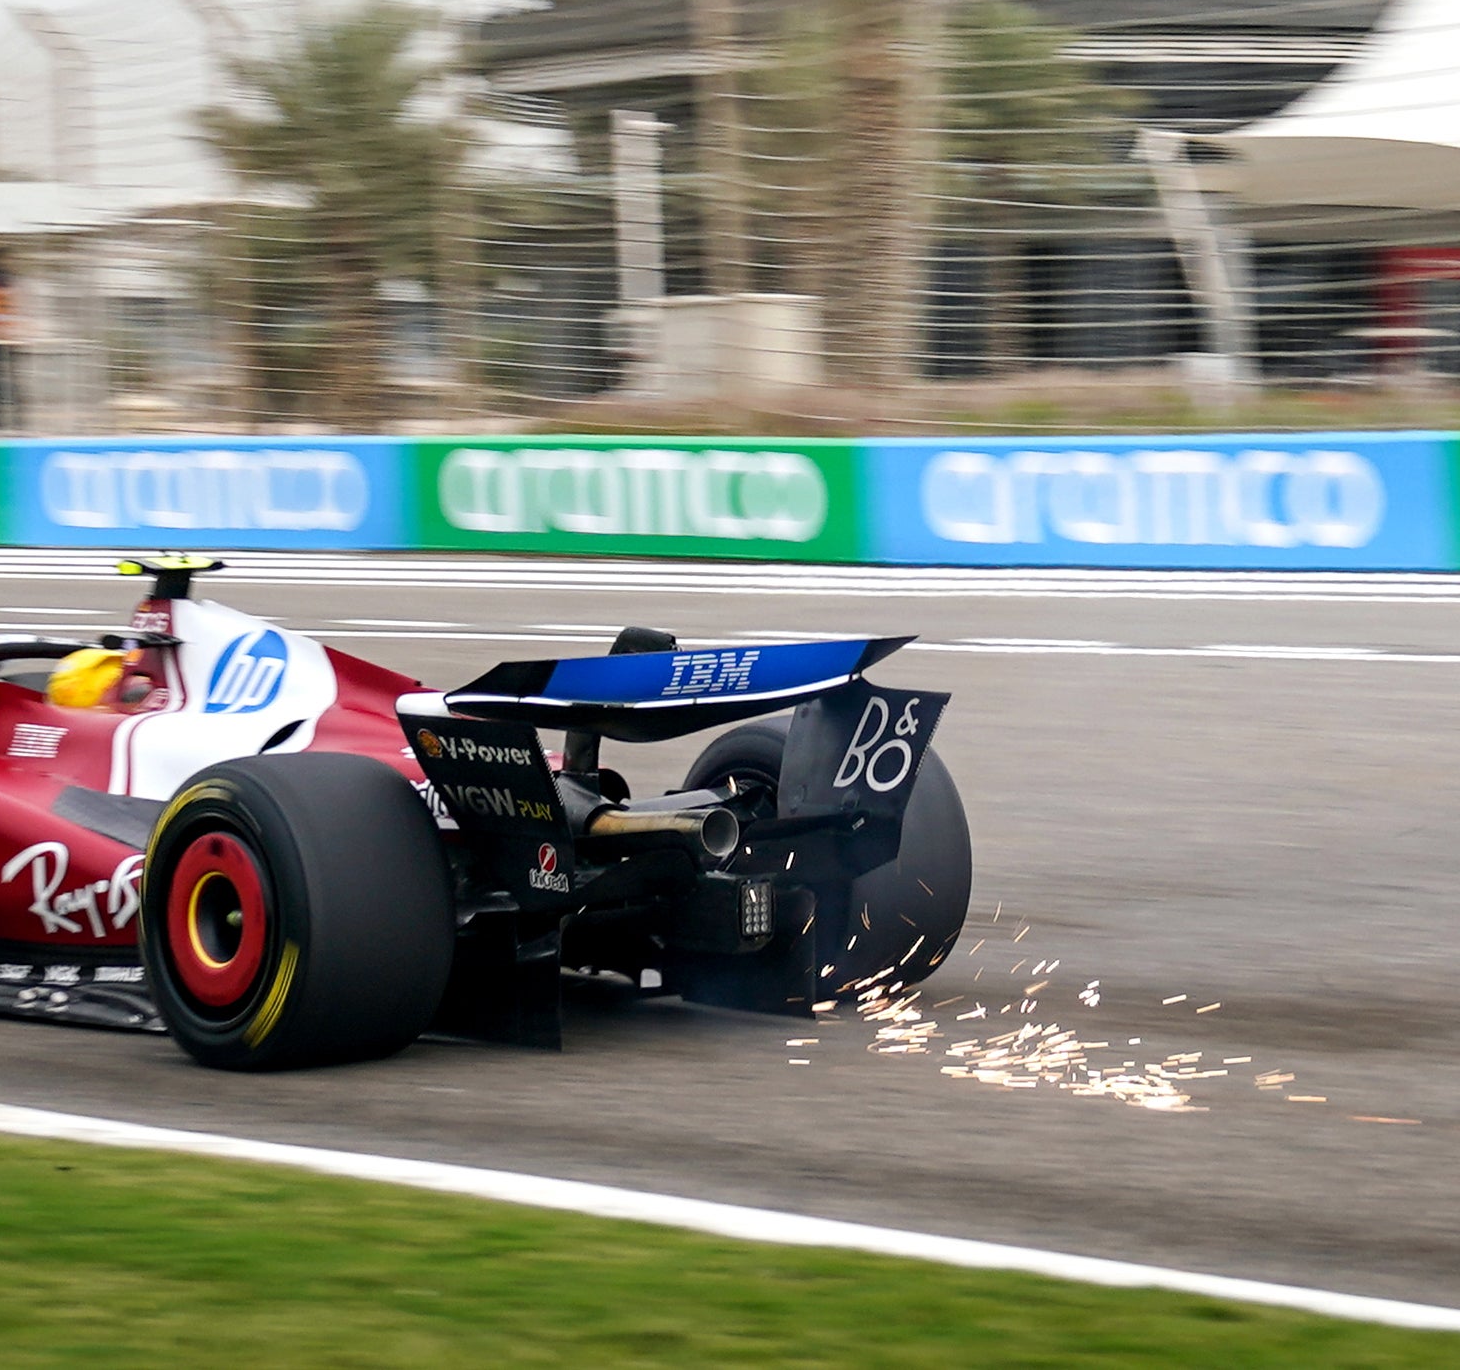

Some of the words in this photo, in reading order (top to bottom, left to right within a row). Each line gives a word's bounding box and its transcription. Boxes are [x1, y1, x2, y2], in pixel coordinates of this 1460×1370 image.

[439, 448, 828, 541] aramco
[922, 450, 1385, 547] aramco
[208, 629, 286, 714] hp
[661, 650, 760, 696] IBM
[438, 735, 532, 766] V-Power
[443, 784, 516, 817] VGW
[517, 799, 554, 821] PLAY
[1, 841, 146, 938] Ray-B
